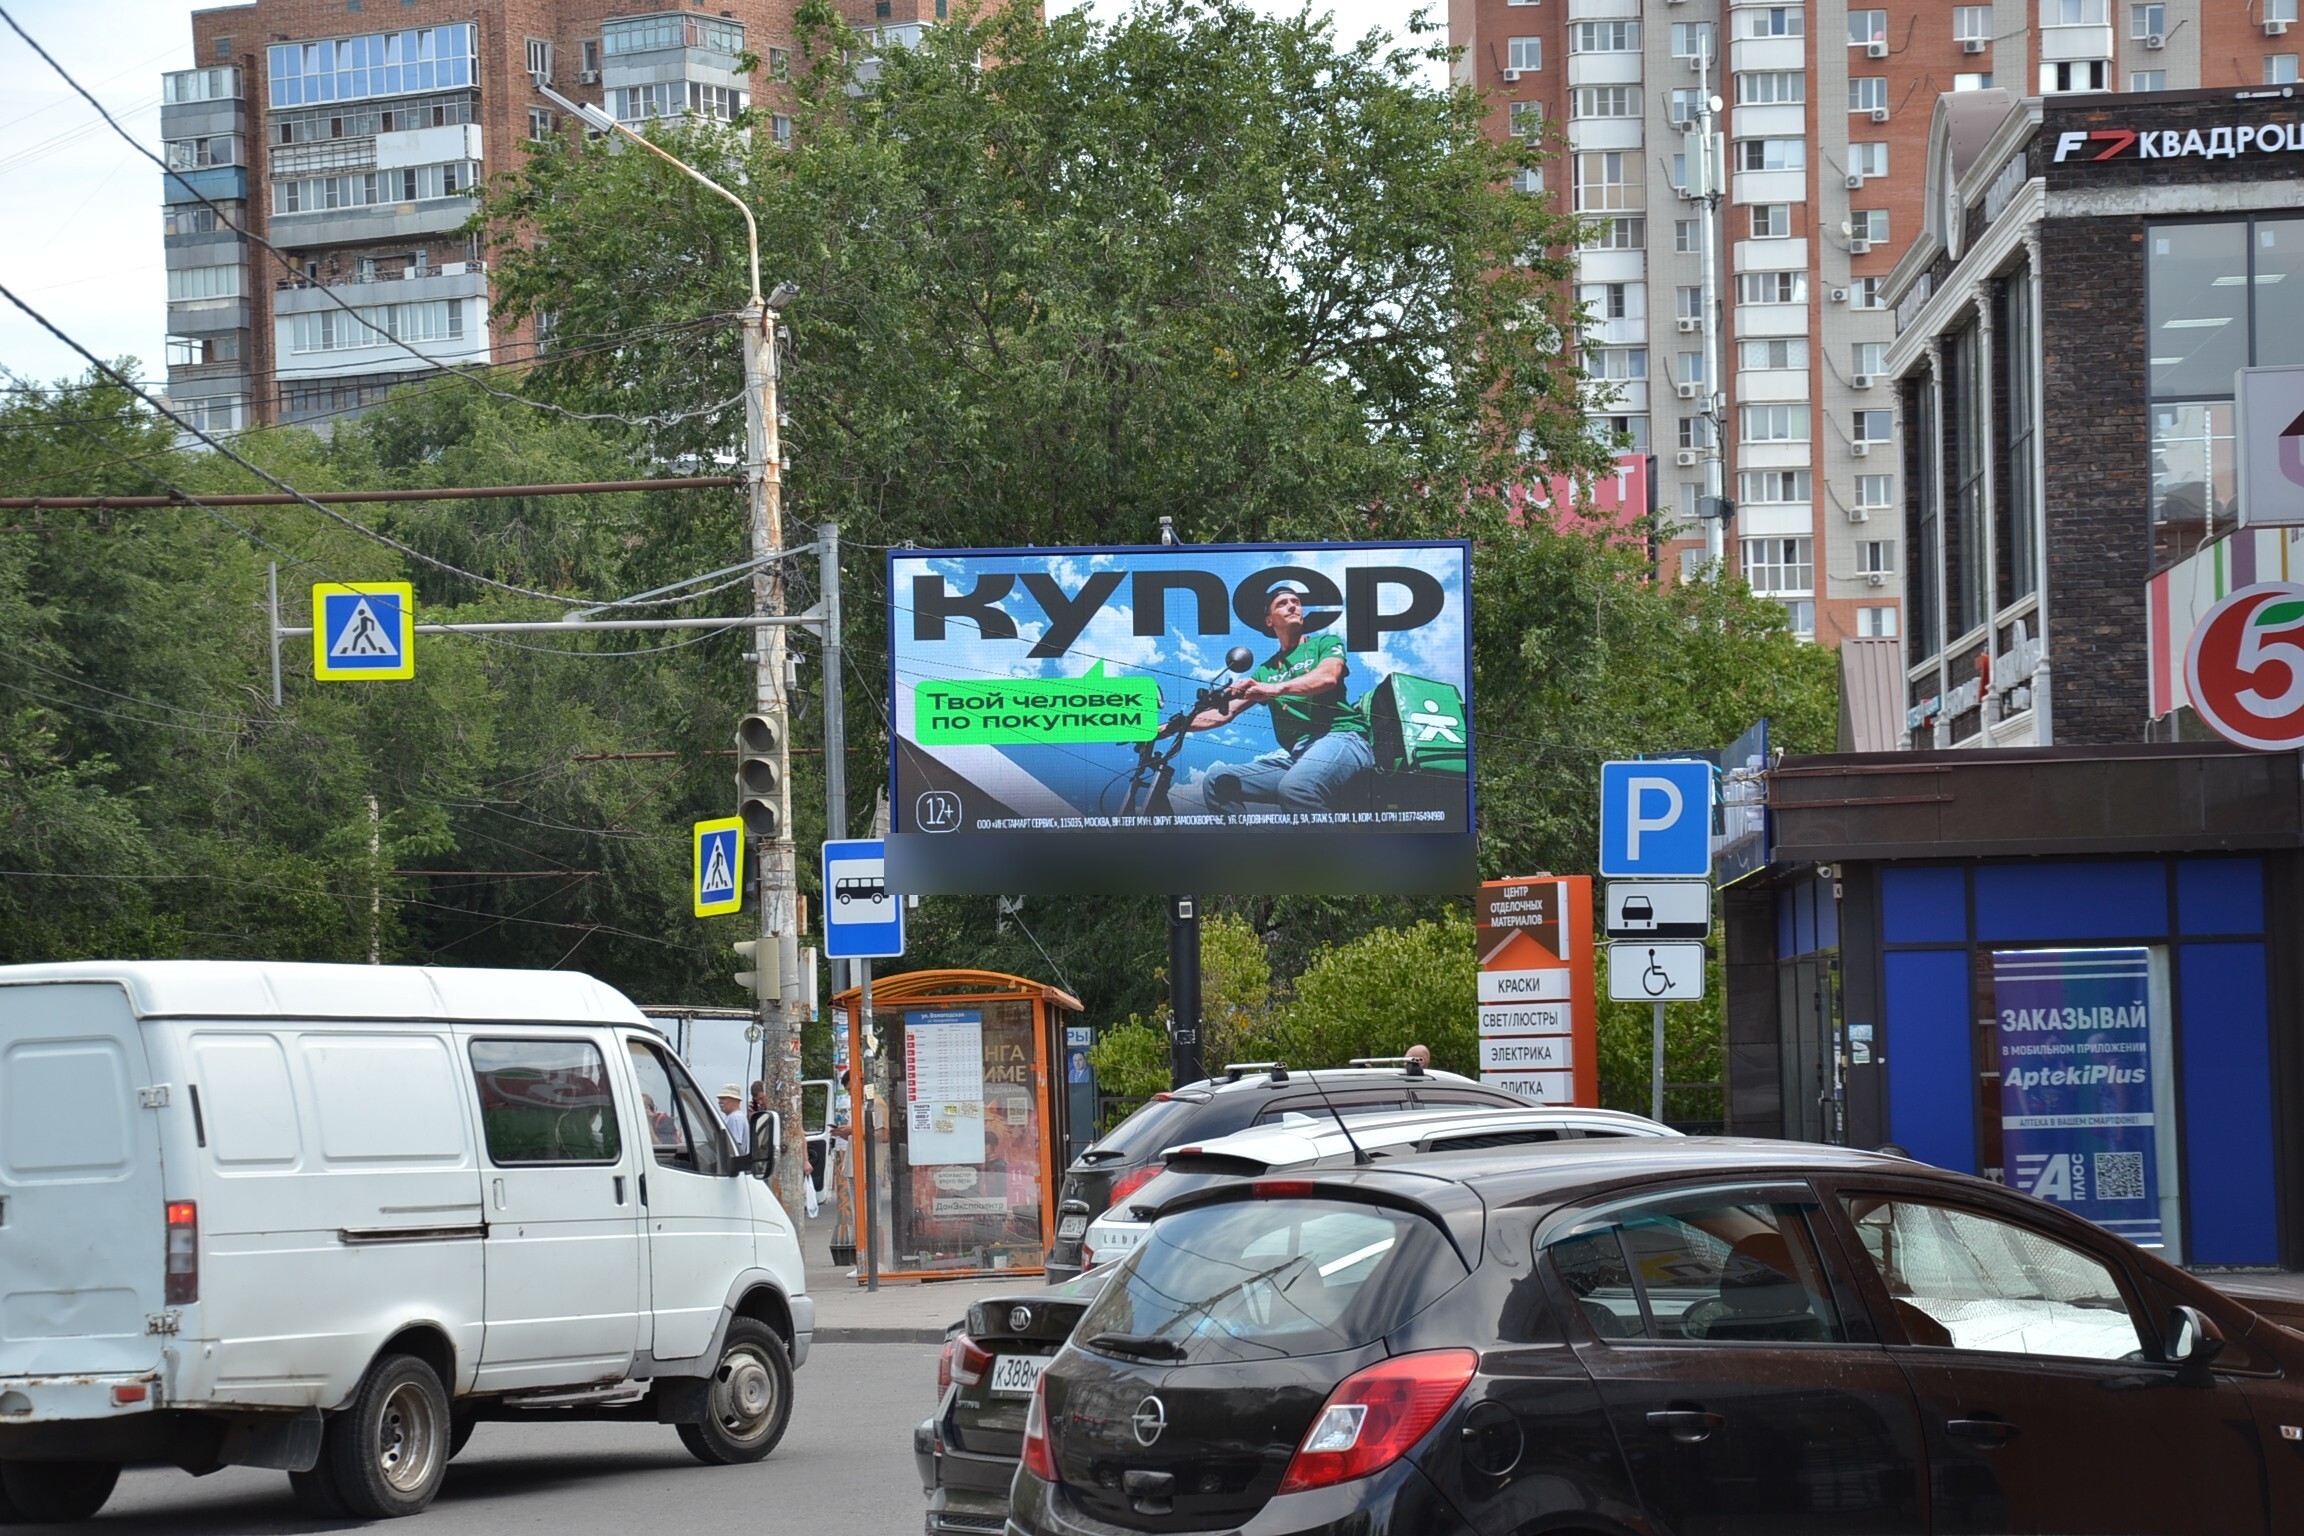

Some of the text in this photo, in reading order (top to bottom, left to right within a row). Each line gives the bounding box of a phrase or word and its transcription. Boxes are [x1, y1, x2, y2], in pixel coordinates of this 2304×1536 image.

[926, 692, 1142, 710] Твой человек
[932, 713, 1142, 731] по покупкам
[926, 797, 954, 825] 12+
[1627, 777, 1683, 860] P
[977, 819, 991, 829] ООО
[1503, 886, 1529, 899] ЦЕНТР
[1490, 900, 1543, 914] ОТДЕЛОЧНЫХ
[1491, 914, 1543, 927] МАТЕРИАЛОВ
[1497, 978, 1540, 994] КРАСКИ
[1483, 1012, 1558, 1027] СВЕТ/ЛЮСТРЫ
[2001, 1000, 2147, 1032] ЗАКАЗЫВАЙ
[985, 1045, 1025, 1061] НГА
[1491, 1046, 1552, 1061] ЭЛЕКТРИКА
[2002, 1042, 2146, 1056] В МОБИЛЬНОМ ПРИЛОЖЕНИИ
[983, 1065, 1027, 1082] ИМЕ
[2004, 1065, 2146, 1090] AptekiPlus
[2019, 1116, 2138, 1127] АПТЕКА В ВАШЕМ СМАРТФОНЕ!
[936, 1202, 1004, 1211] ДонЭкспоцентр
[1103, 1235, 1139, 1245] LADA
[1012, 1311, 1026, 1326] KIA
[995, 1359, 1042, 1388] К388М
